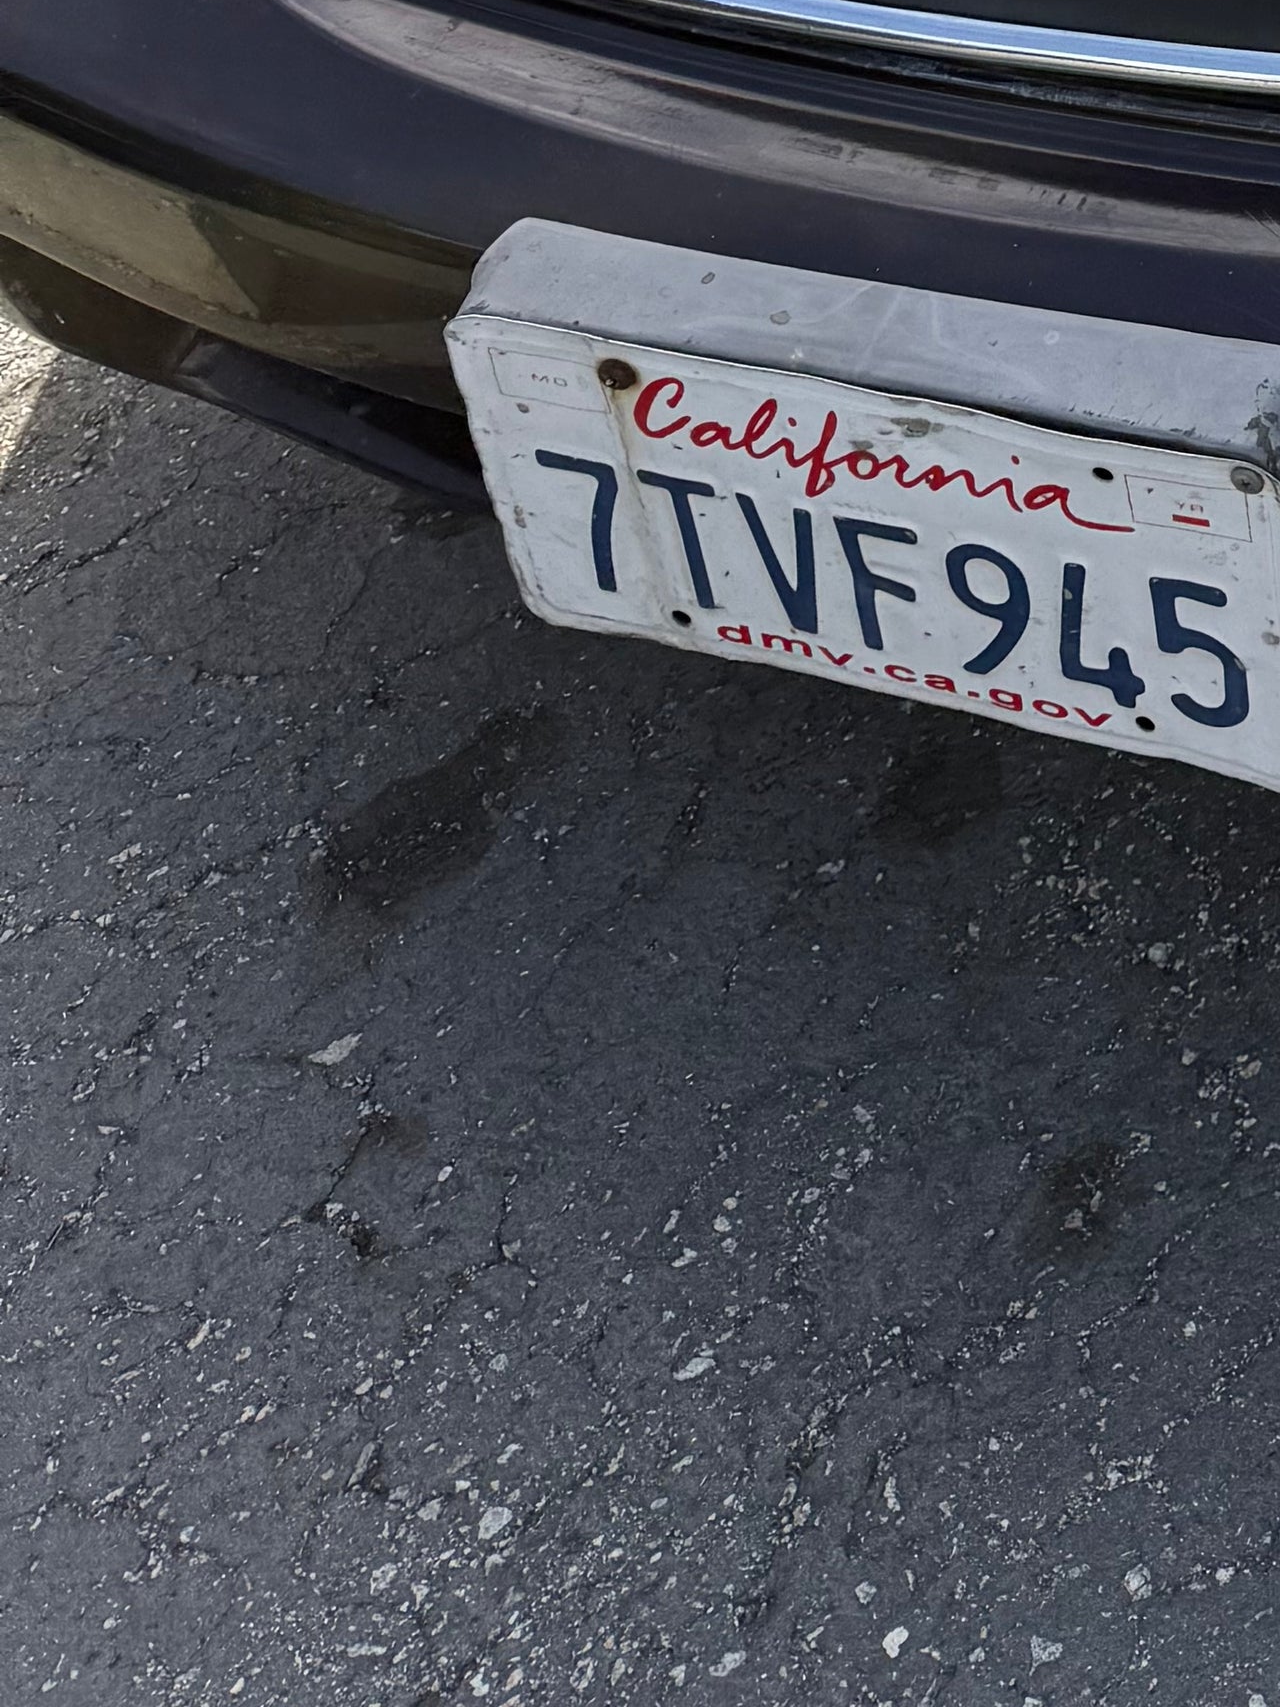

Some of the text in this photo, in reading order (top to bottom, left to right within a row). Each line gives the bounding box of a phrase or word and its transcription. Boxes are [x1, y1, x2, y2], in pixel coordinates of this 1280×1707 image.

[633, 377, 1135, 533] California
[535, 449, 1250, 729] 7TVF945
[716, 625, 1113, 728] dmv.ca.gov
